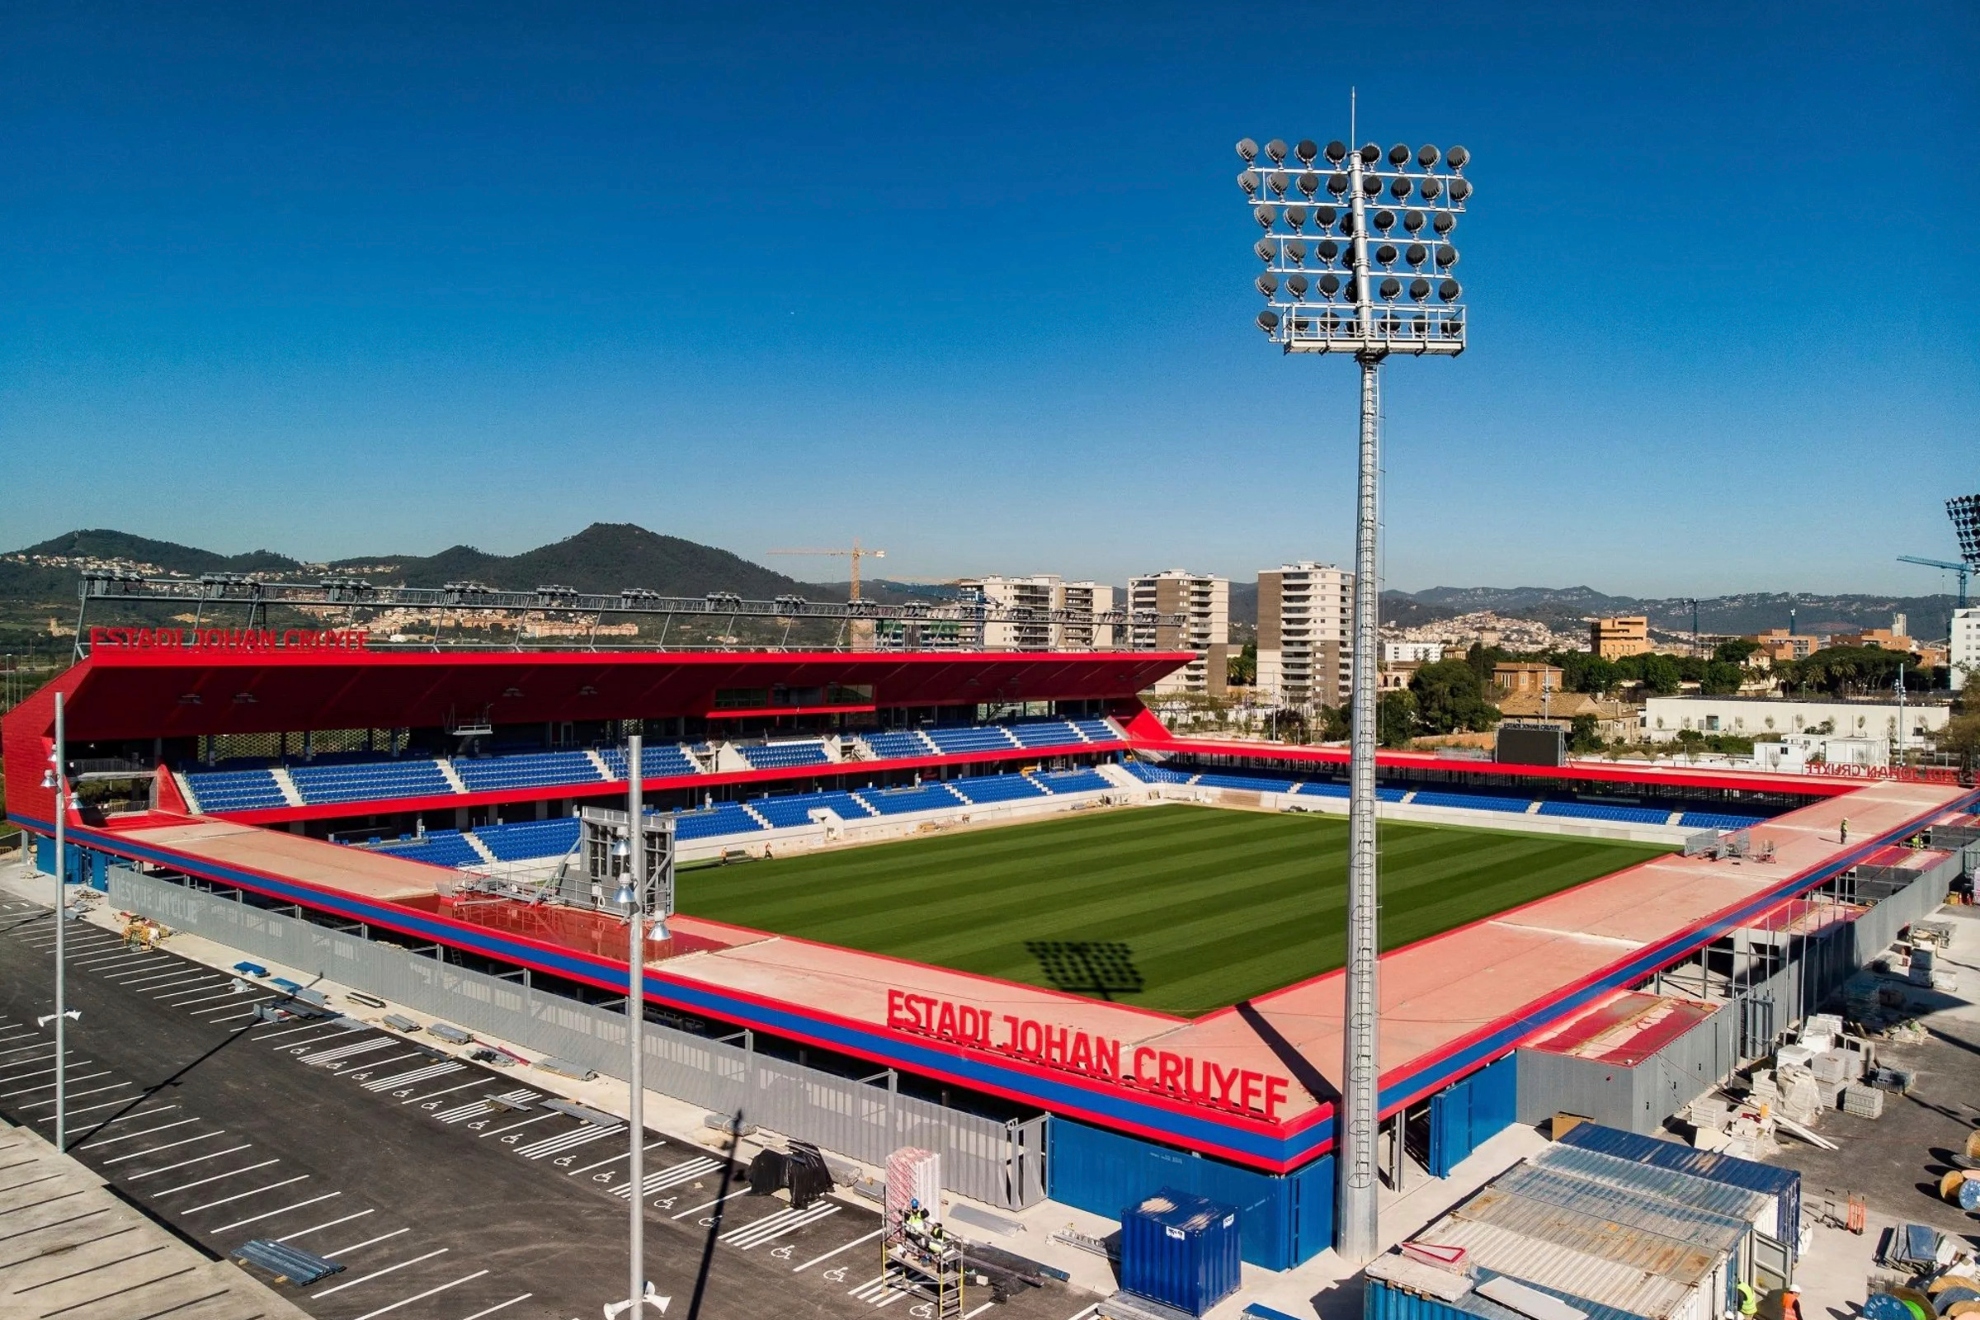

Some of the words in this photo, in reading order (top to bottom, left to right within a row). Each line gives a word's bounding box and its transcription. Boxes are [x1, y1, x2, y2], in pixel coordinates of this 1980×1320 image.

[90, 627, 183, 650] ESTADI
[191, 629, 275, 651] JOHAN
[284, 629, 370, 651] CRUYFF
[887, 989, 993, 1048] ESTADI
[1001, 1015, 1120, 1078] JOHAN
[1133, 1046, 1289, 1118] CRUYFF
